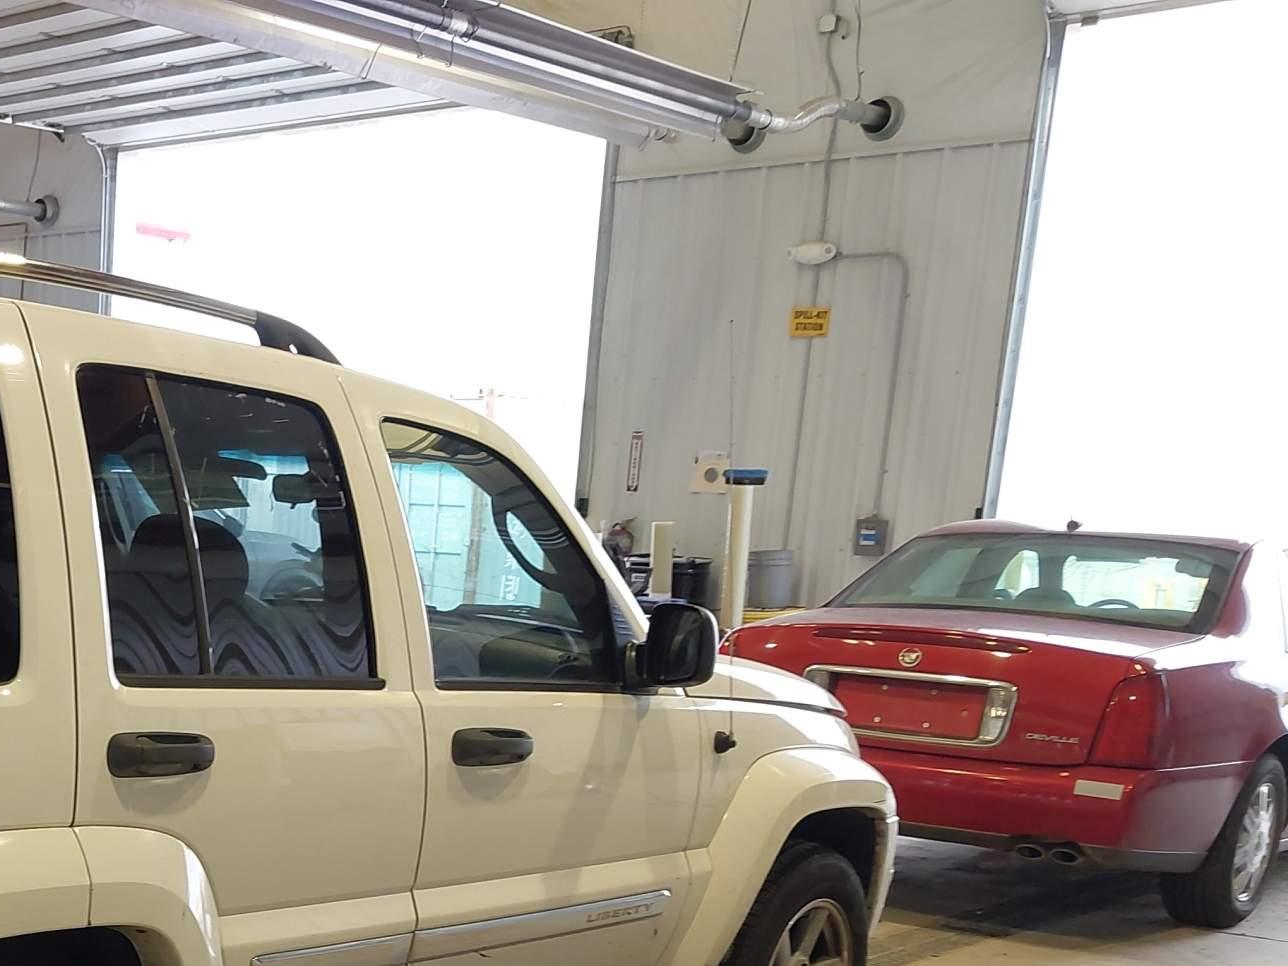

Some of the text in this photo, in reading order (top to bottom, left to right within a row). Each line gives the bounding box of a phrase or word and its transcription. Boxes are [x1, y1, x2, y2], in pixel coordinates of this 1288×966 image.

[795, 322, 824, 331] STATION
[1025, 732, 1080, 744] DEVILLE
[586, 902, 656, 923] LIBERTY
